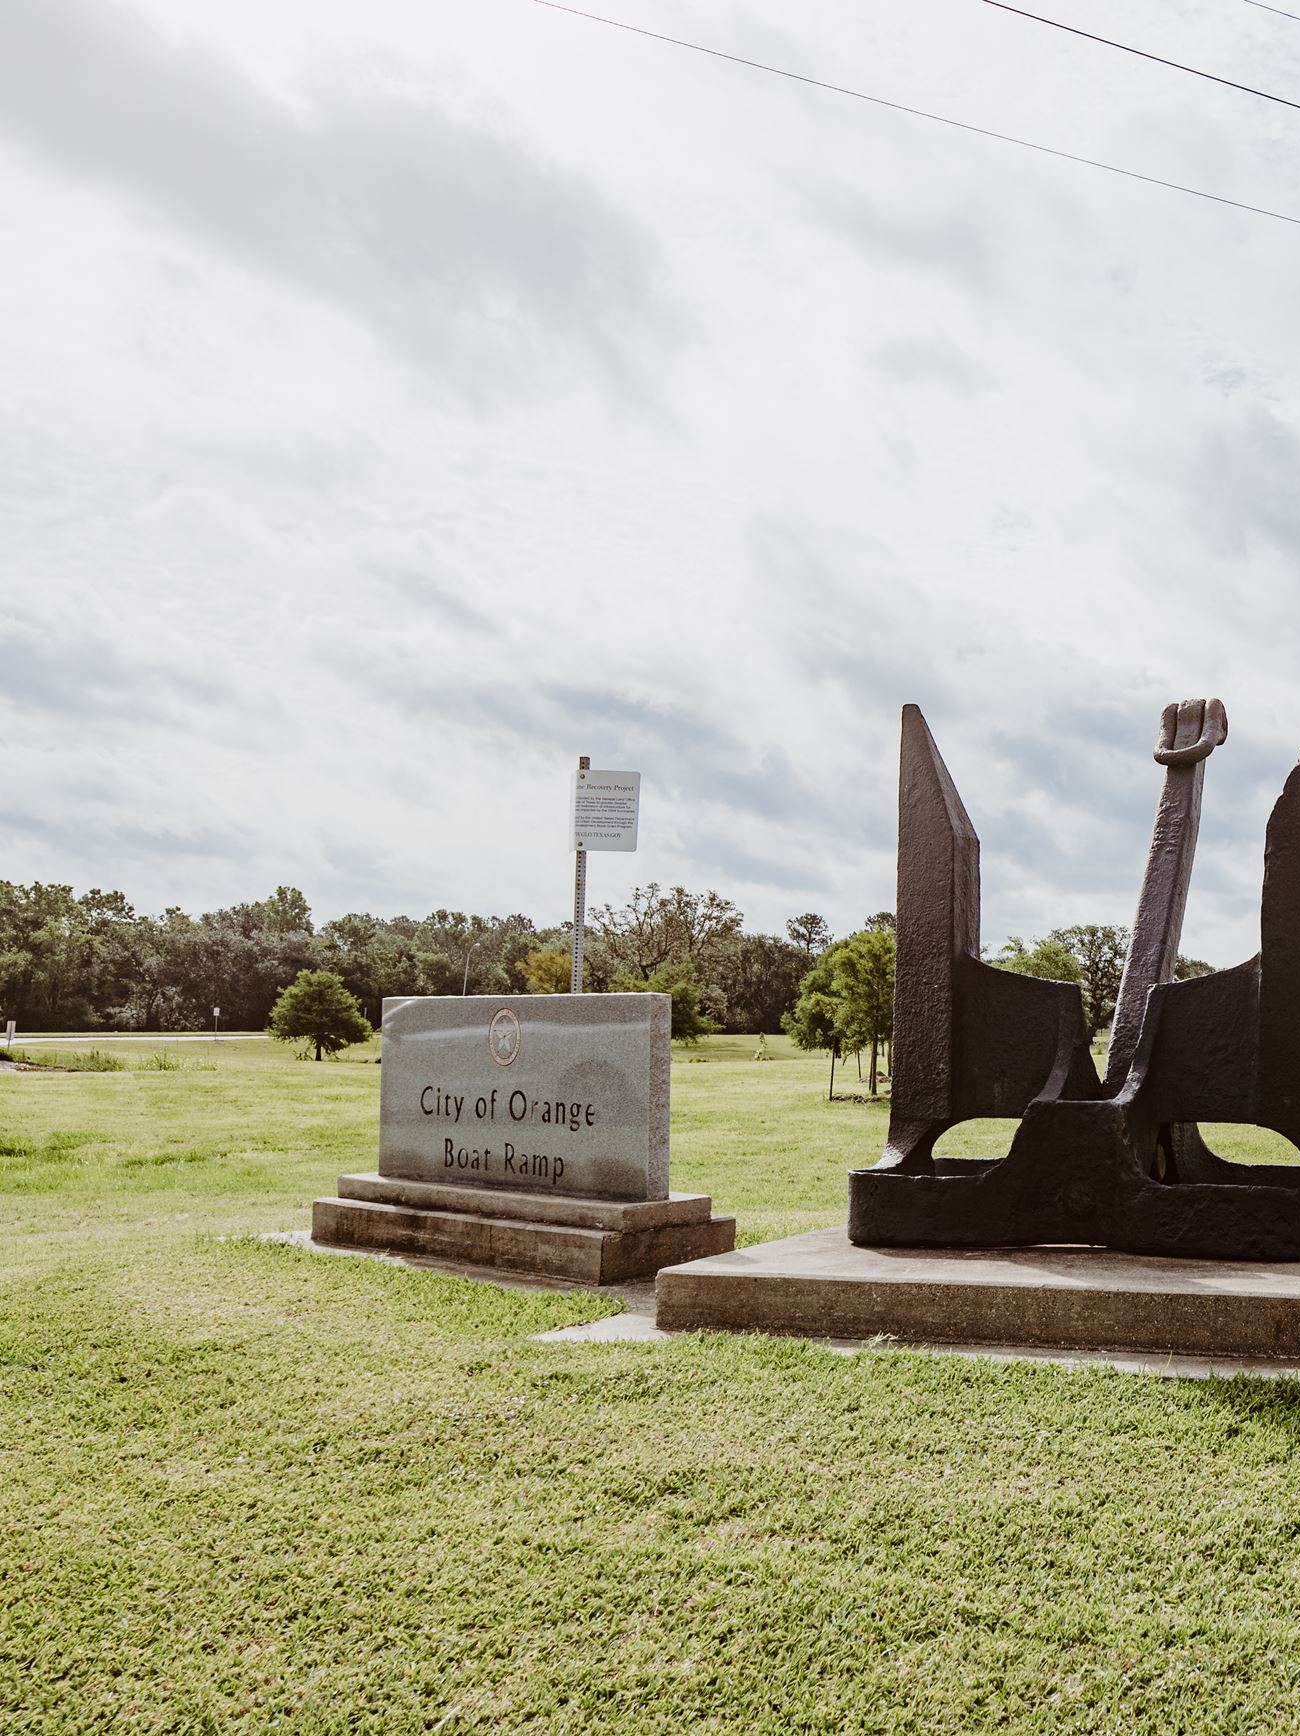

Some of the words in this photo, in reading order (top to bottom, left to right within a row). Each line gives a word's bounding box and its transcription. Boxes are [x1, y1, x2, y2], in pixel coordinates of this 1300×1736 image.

[420, 1086, 465, 1123] City
[475, 1089, 498, 1120] of
[509, 1090, 596, 1132] Orange
[444, 1138, 492, 1171] Boat
[504, 1142, 565, 1185] Ramp
